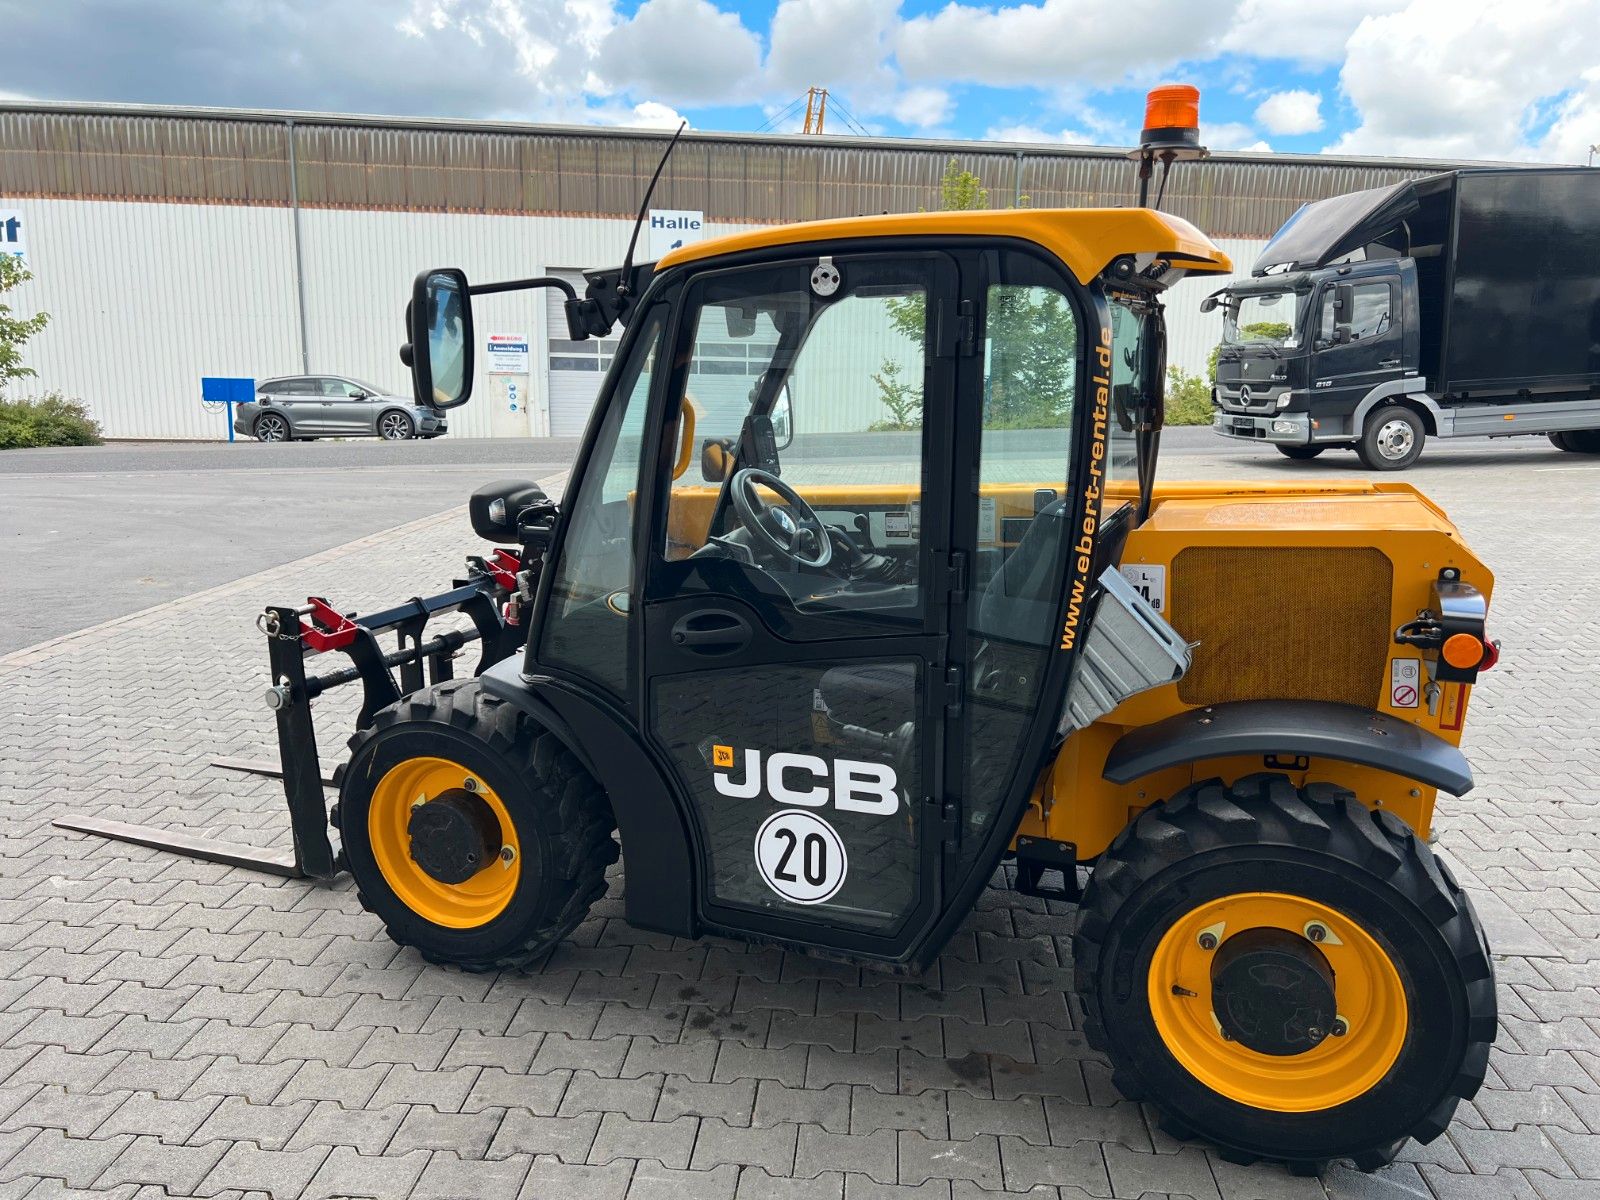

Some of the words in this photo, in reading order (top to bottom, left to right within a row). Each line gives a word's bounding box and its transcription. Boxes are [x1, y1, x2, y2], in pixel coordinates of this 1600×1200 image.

[651, 215, 701, 230] Halle
[1060, 327, 1112, 650] www.ebert-rental.de
[1151, 598, 1161, 609] dB
[713, 748, 899, 816] JCB
[774, 828, 827, 887] 20
